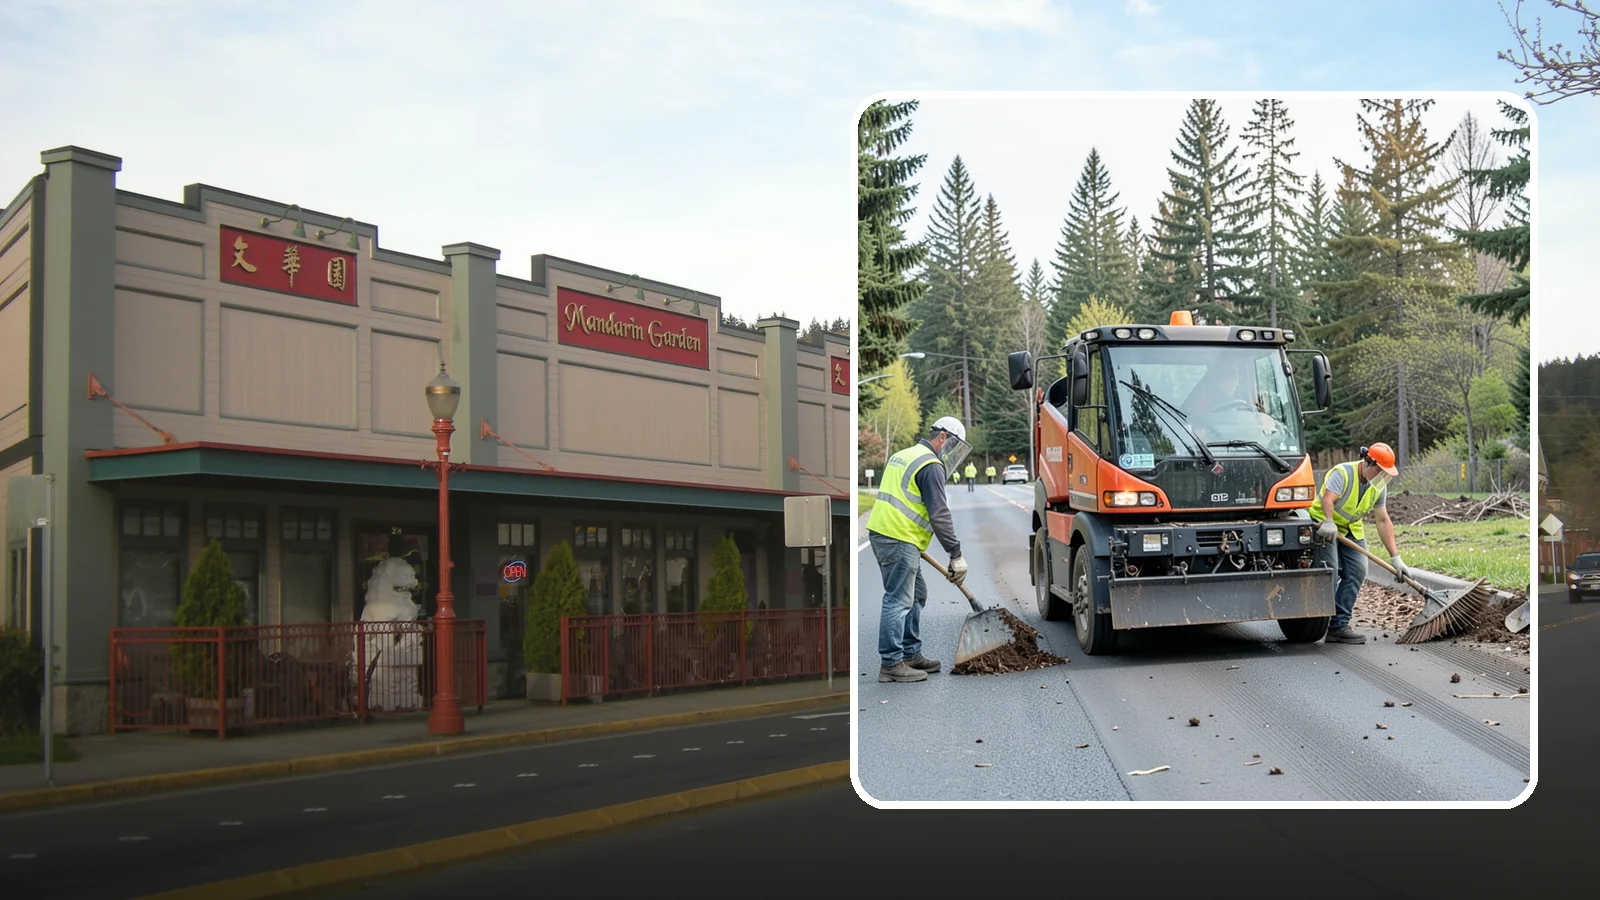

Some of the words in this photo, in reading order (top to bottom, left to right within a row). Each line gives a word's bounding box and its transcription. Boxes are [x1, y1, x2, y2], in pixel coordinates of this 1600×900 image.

[231, 235, 347, 291] 文華園
[564, 302, 644, 341] Mandarin
[648, 320, 702, 352] Garden
[503, 565, 527, 578] OPEN
